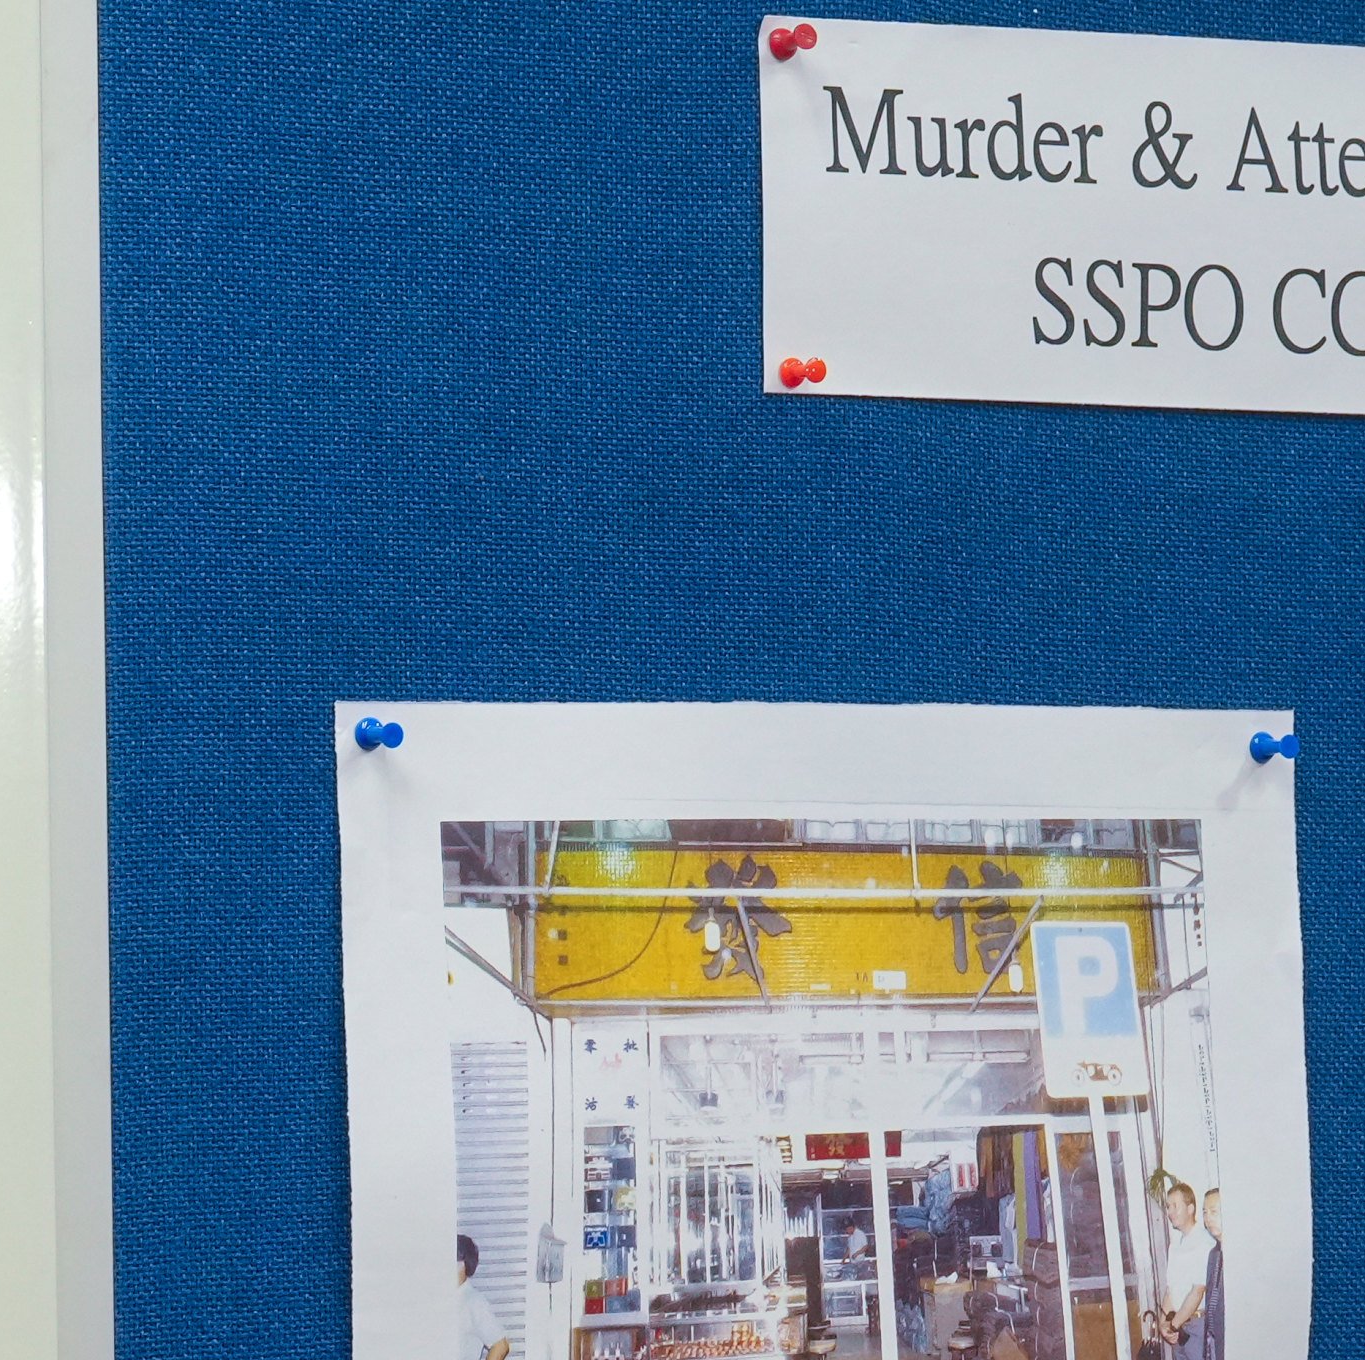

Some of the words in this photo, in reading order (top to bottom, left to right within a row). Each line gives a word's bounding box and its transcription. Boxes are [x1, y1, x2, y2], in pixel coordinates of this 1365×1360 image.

[823, 86, 1103, 184] Murder
[1132, 101, 1198, 190] &
[1033, 258, 1244, 351] SSPO
[1054, 935, 1119, 1038] P
